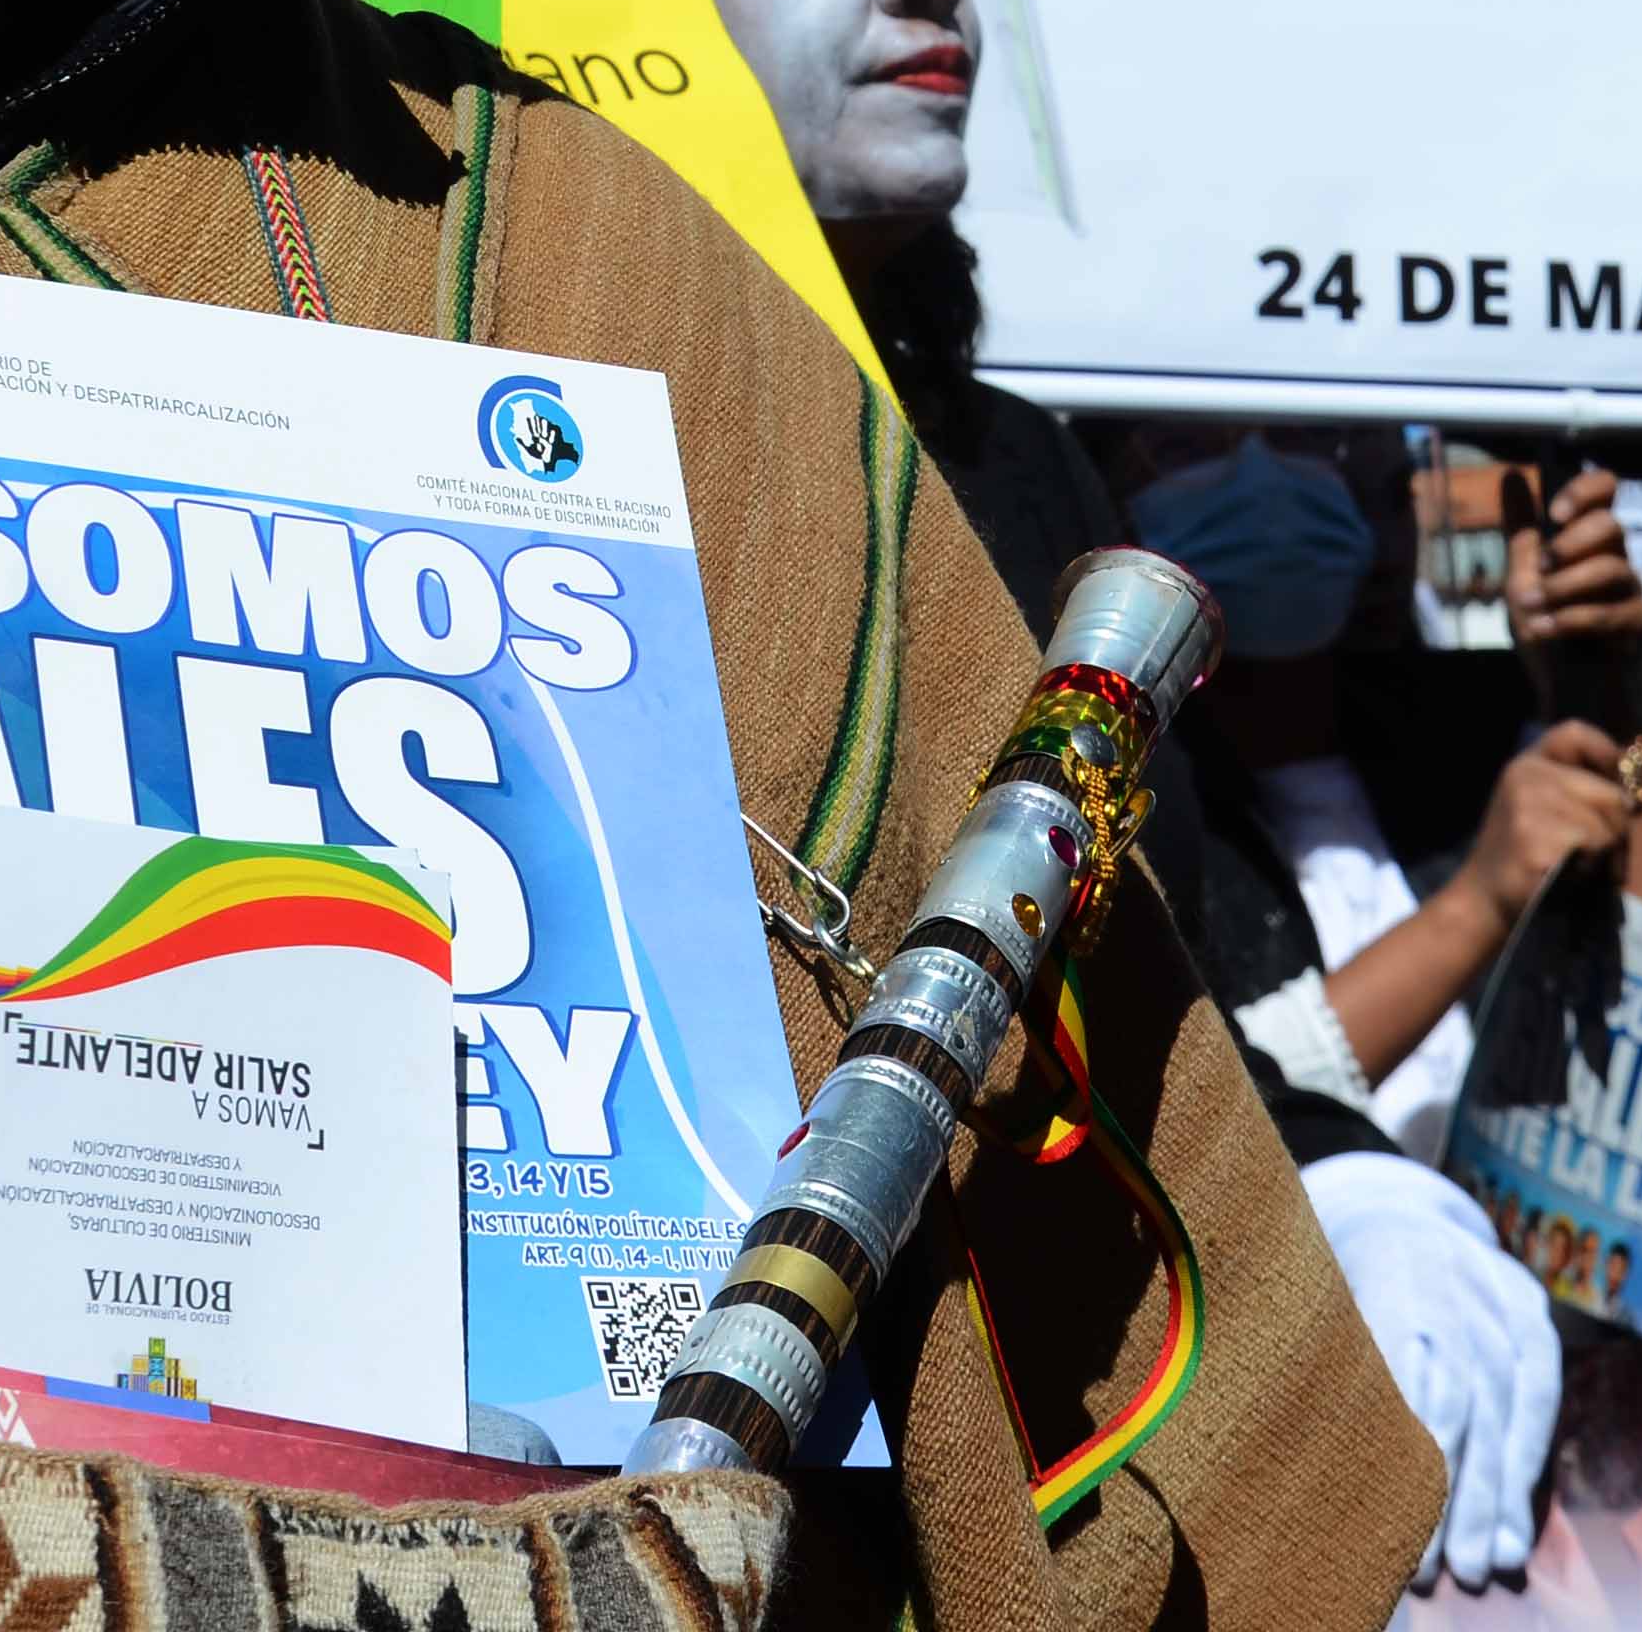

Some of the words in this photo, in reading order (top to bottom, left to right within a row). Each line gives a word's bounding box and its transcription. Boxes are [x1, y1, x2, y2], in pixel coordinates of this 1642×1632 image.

[1255, 248, 1363, 323] 24
[1397, 255, 1510, 328] DE
[27, 359, 52, 378] DE
[57, 380, 68, 397] Y
[73, 383, 291, 432] DESPATRIARCALIZACIÓN
[416, 473, 467, 495] COMITÉ
[470, 480, 538, 503] NACIONAL
[540, 490, 593, 510] CONTRA
[595, 497, 612, 512] EL
[614, 499, 672, 519] RACISMO
[433, 494, 443, 508] Y
[445, 495, 481, 512] TODA
[484, 501, 531, 520] FORMA
[534, 506, 553, 521] DE
[555, 509, 660, 534] DISCRIMINACIÓN
[16, 1026, 204, 1082] ADELANTE
[213, 1051, 313, 1099] SALIR
[193, 1089, 207, 1122] A
[218, 1093, 314, 1133] VAMOS
[72, 1138, 229, 1170] DESPATRIARCALIZACIÓN
[232, 1154, 243, 1171] Y
[28, 1157, 158, 1185] DESCOLONIZACIÓN
[159, 1169, 176, 1186] DE
[178, 1171, 282, 1198] VICEMINISTERIO
[508, 1164, 543, 1193] 14
[550, 1165, 569, 1194] Y
[577, 1166, 610, 1195] 15
[177, 1201, 187, 1217] Y
[189, 1200, 321, 1232] DESCOLONIZACIÓN
[68, 1211, 146, 1240] CULTURAS,
[149, 1222, 167, 1240] DE
[171, 1222, 252, 1248] MINISTERIO
[596, 1213, 681, 1239] POLÍTICA
[686, 1222, 721, 1240] DEL
[524, 1246, 564, 1266] ART.
[570, 1247, 583, 1264] 9
[625, 1249, 647, 1265] 14
[697, 1251, 711, 1267] Y
[84, 1268, 233, 1313] BOLIVIA
